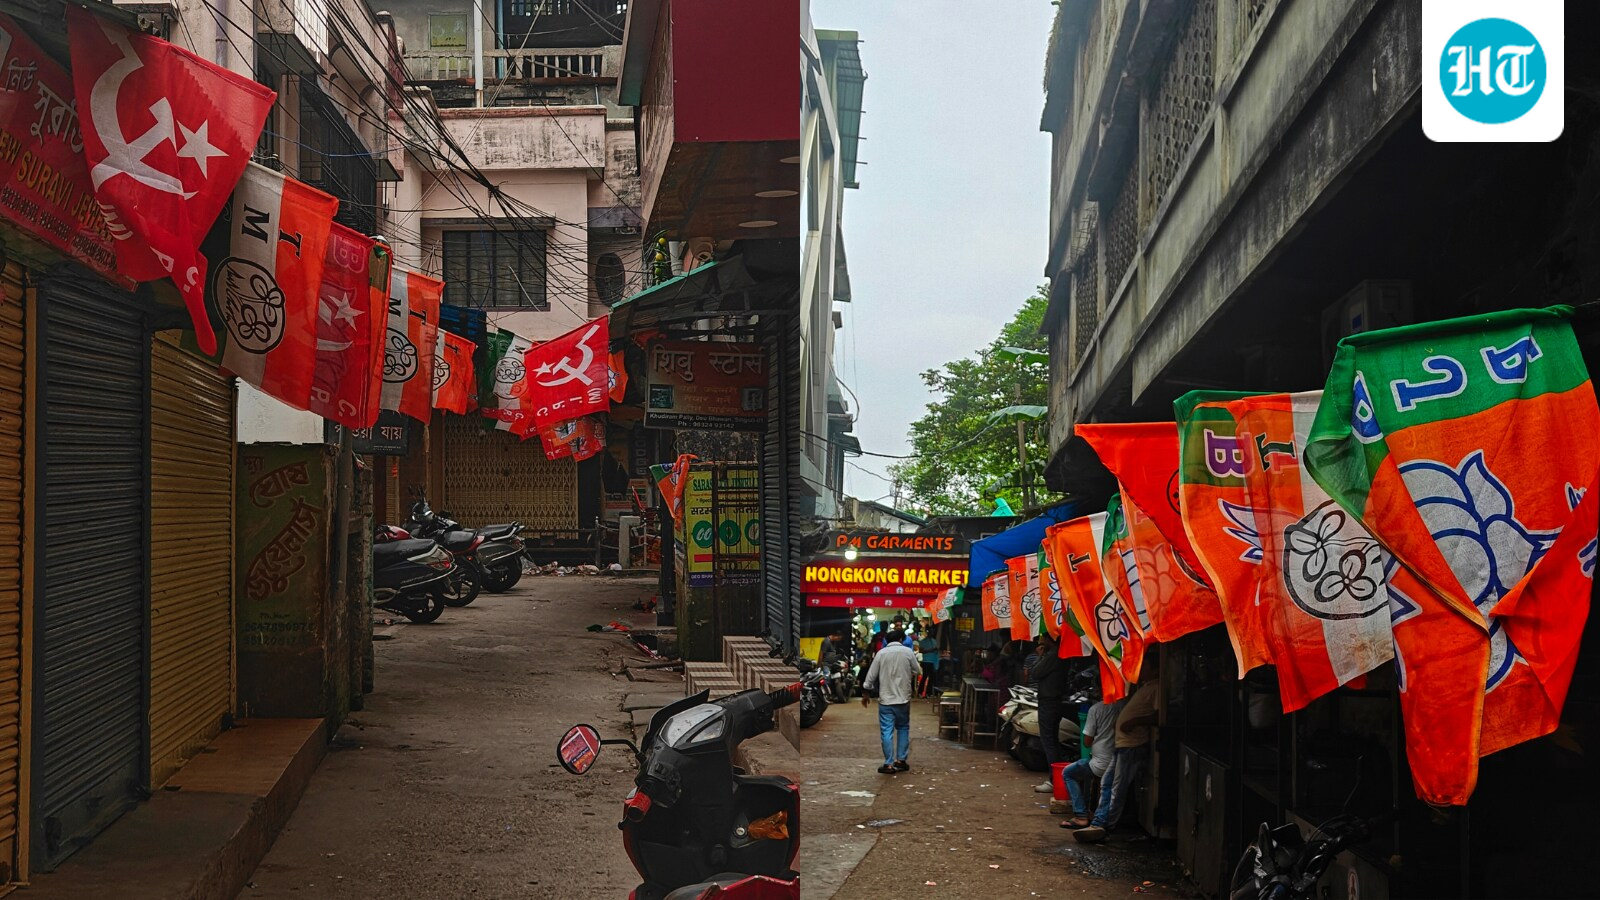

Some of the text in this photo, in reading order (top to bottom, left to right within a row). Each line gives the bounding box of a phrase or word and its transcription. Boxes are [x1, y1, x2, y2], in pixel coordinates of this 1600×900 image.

[17, 150, 74, 213] SURAVI
[242, 204, 270, 244] M
[279, 229, 302, 259] T
[836, 534, 955, 551] PM GARMENTS
[804, 566, 970, 586] HONGKONG MARKET
